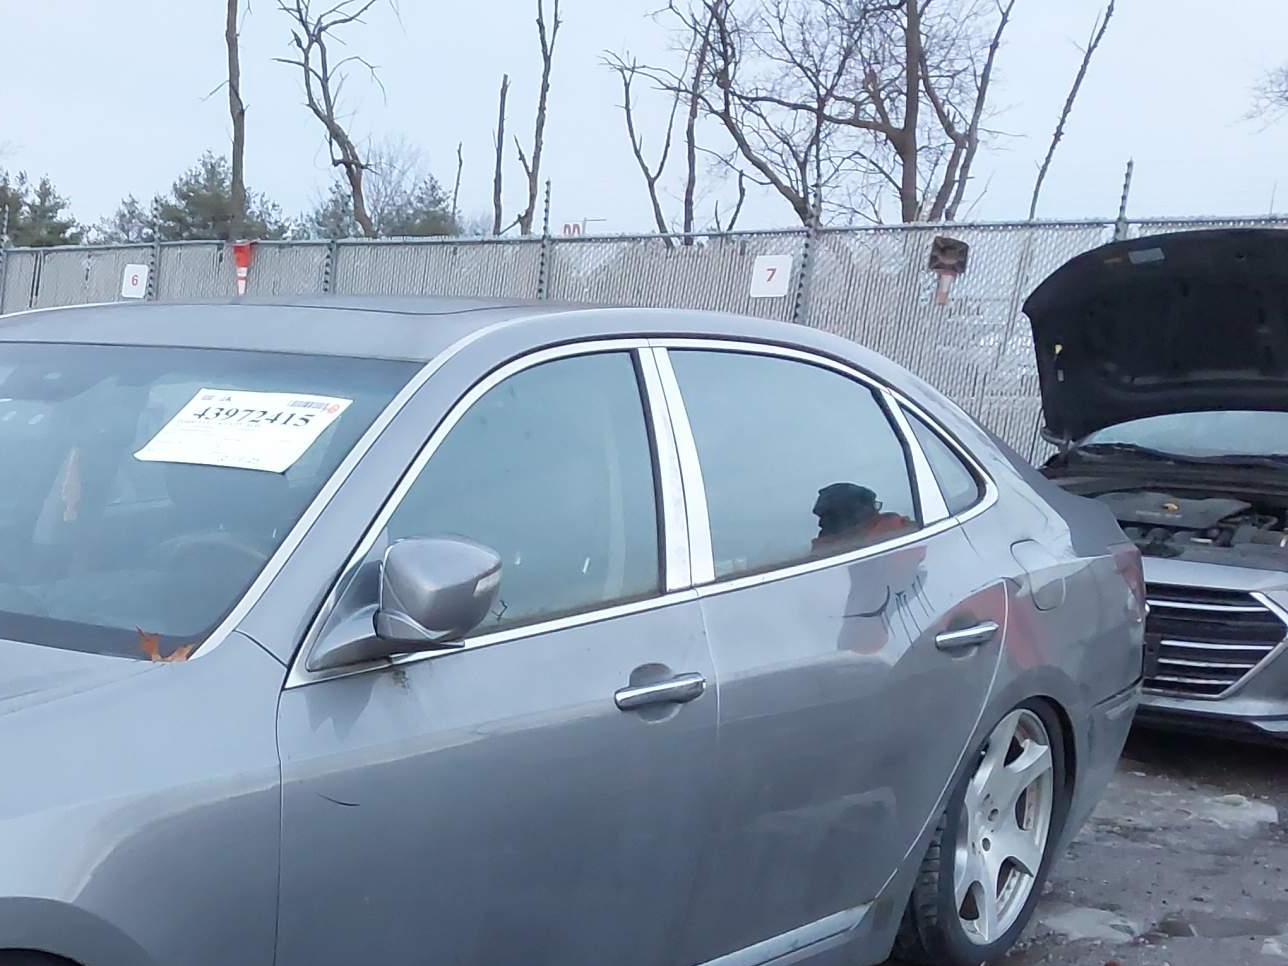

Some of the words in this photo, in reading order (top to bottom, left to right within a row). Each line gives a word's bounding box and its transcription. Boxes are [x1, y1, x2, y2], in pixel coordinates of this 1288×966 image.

[131, 274, 139, 287] 6
[765, 267, 777, 282] 7
[193, 406, 316, 427] 43972415
